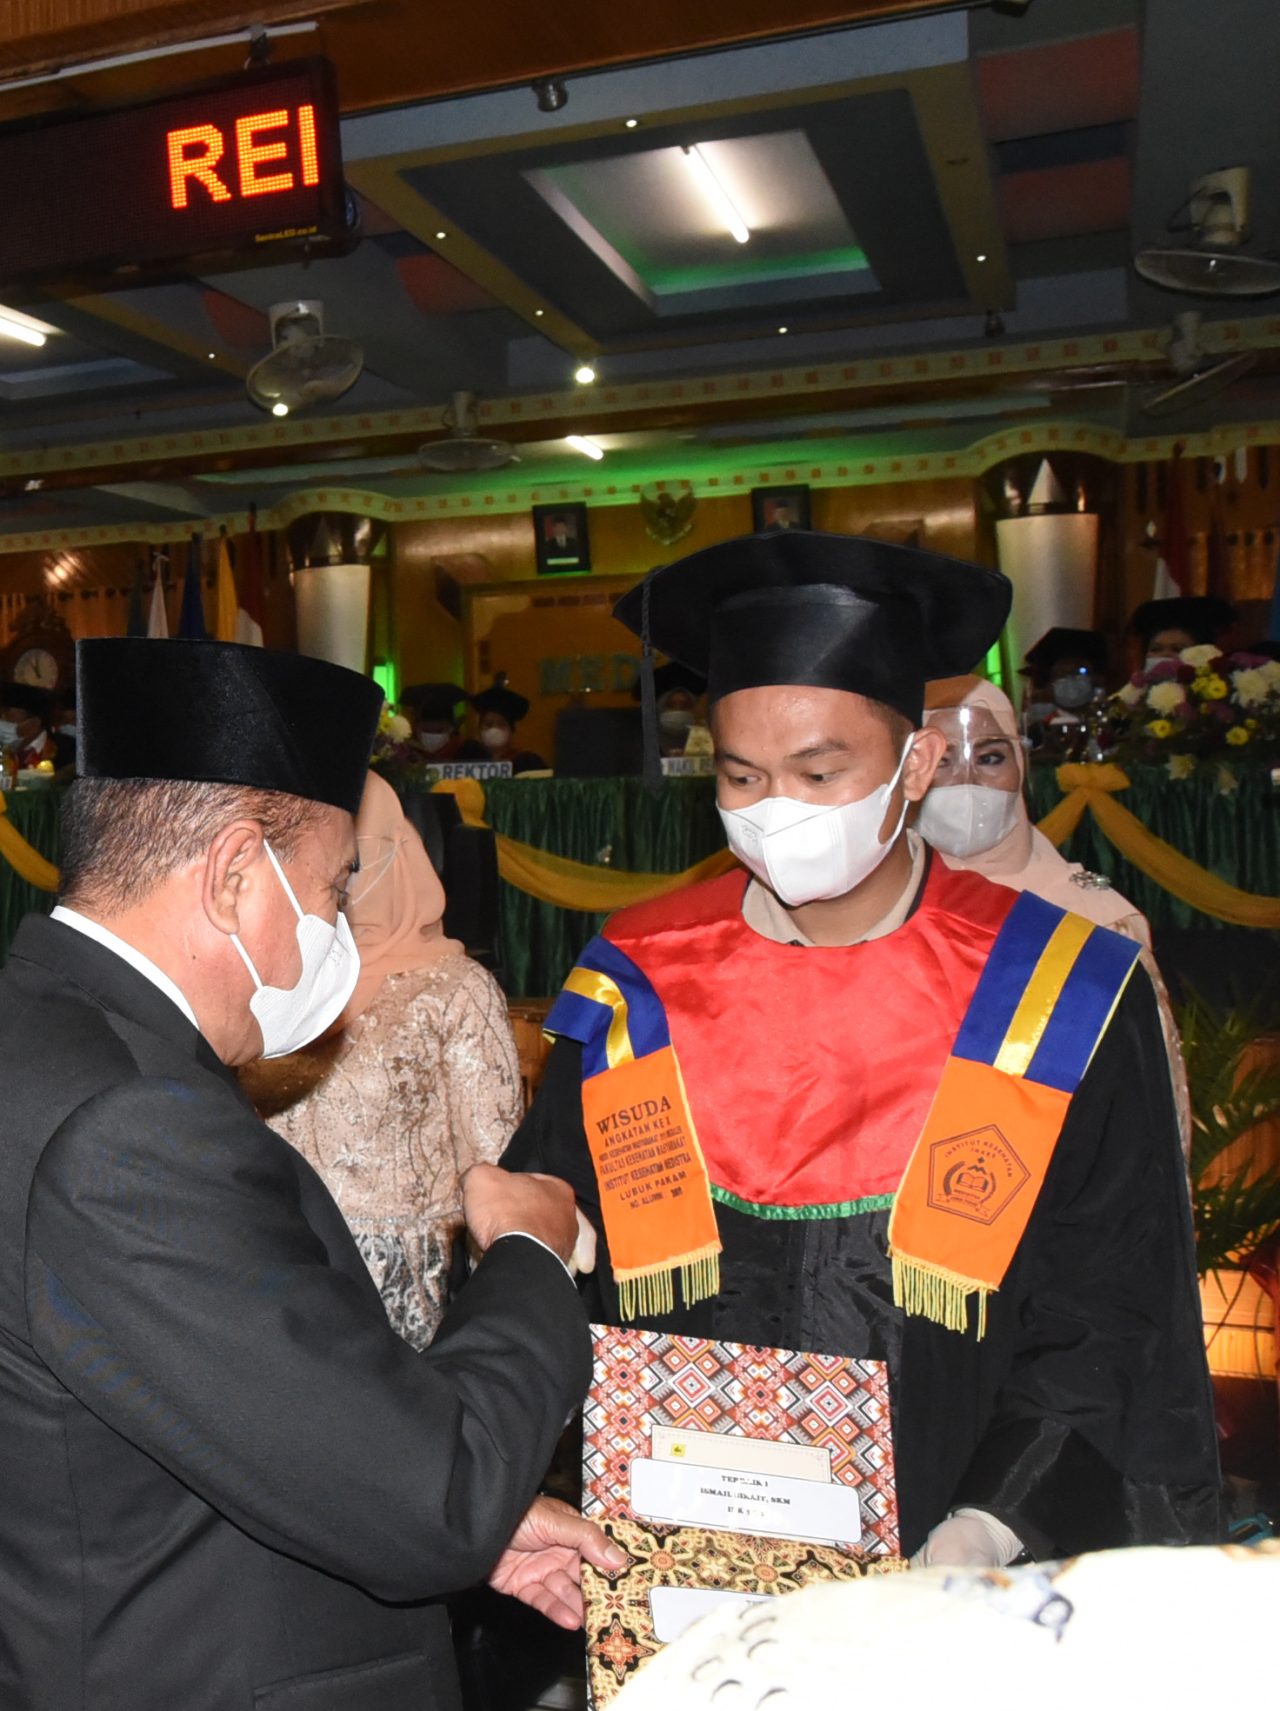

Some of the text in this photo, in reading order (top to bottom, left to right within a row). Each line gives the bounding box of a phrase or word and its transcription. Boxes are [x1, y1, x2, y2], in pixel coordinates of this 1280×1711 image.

[167, 104, 320, 209] REI
[443, 763, 510, 780] REKTOR
[596, 1095, 671, 1135] WISUDA
[604, 1121, 651, 1147] ANGKATAN
[619, 1183, 653, 1201] LUBUK
[655, 1170, 687, 1188] PAKAM
